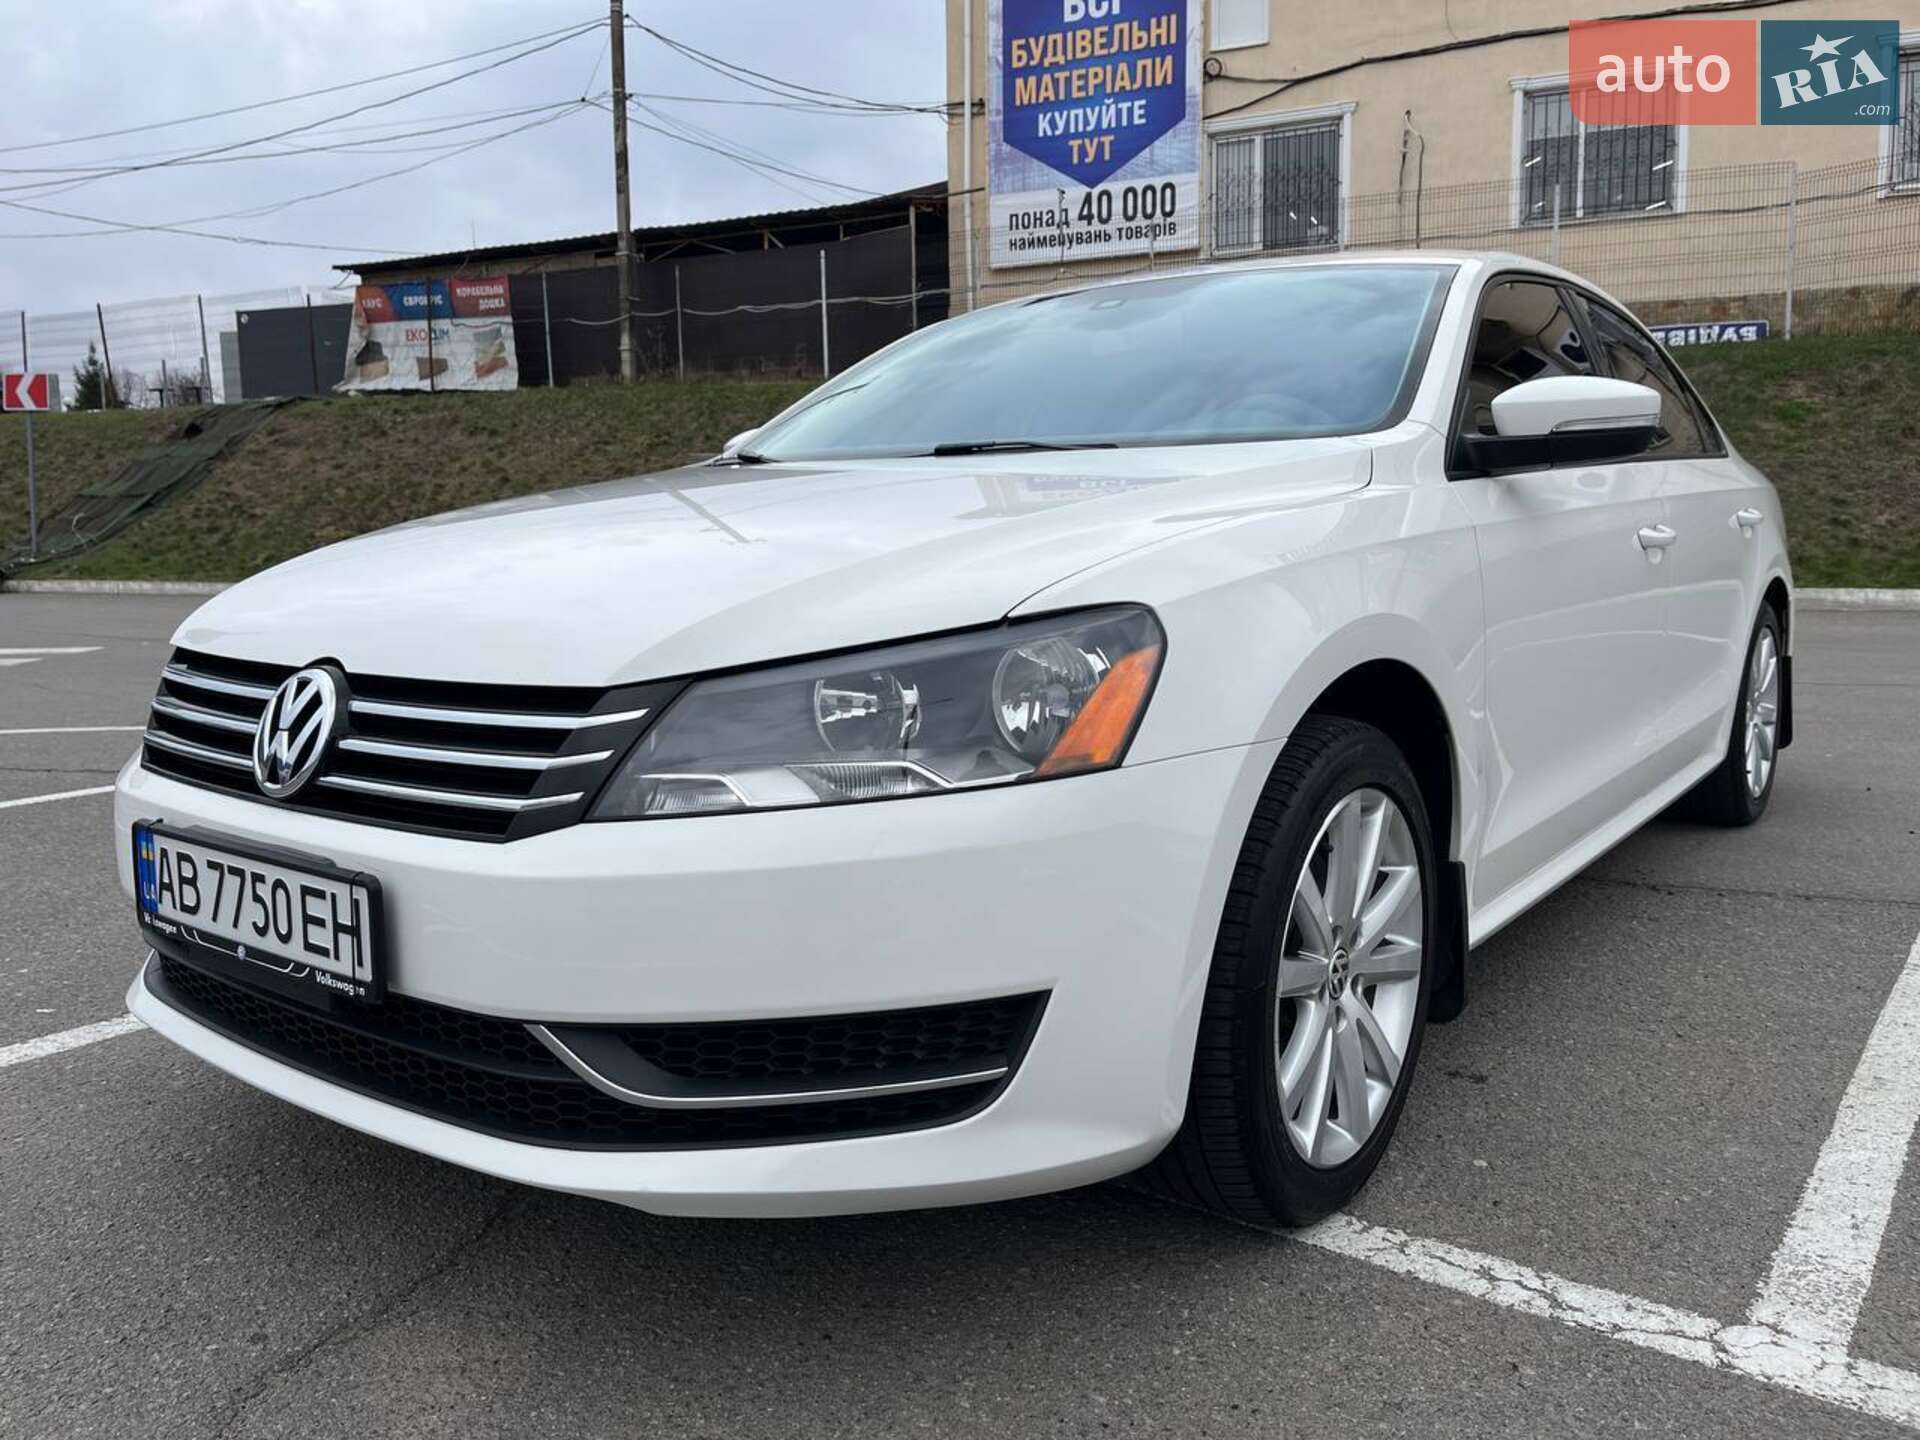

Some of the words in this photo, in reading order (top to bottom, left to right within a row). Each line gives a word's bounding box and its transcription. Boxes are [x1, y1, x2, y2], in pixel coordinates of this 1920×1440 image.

[1010, 14, 1178, 69] БУДІВЕЛЬНІ
[1014, 55, 1174, 106] МАТЕРІАЛИ
[1037, 98, 1147, 137] КУПУЙТЕ
[1068, 135, 1115, 165] ТУТ
[1009, 208, 1071, 231] понад
[1077, 189, 1113, 226] 40
[1122, 181, 1177, 222] 000
[1009, 230, 1112, 251] найменувань
[158, 847, 201, 916] AB
[206, 859, 294, 945] 7750
[299, 884, 364, 969] EH
